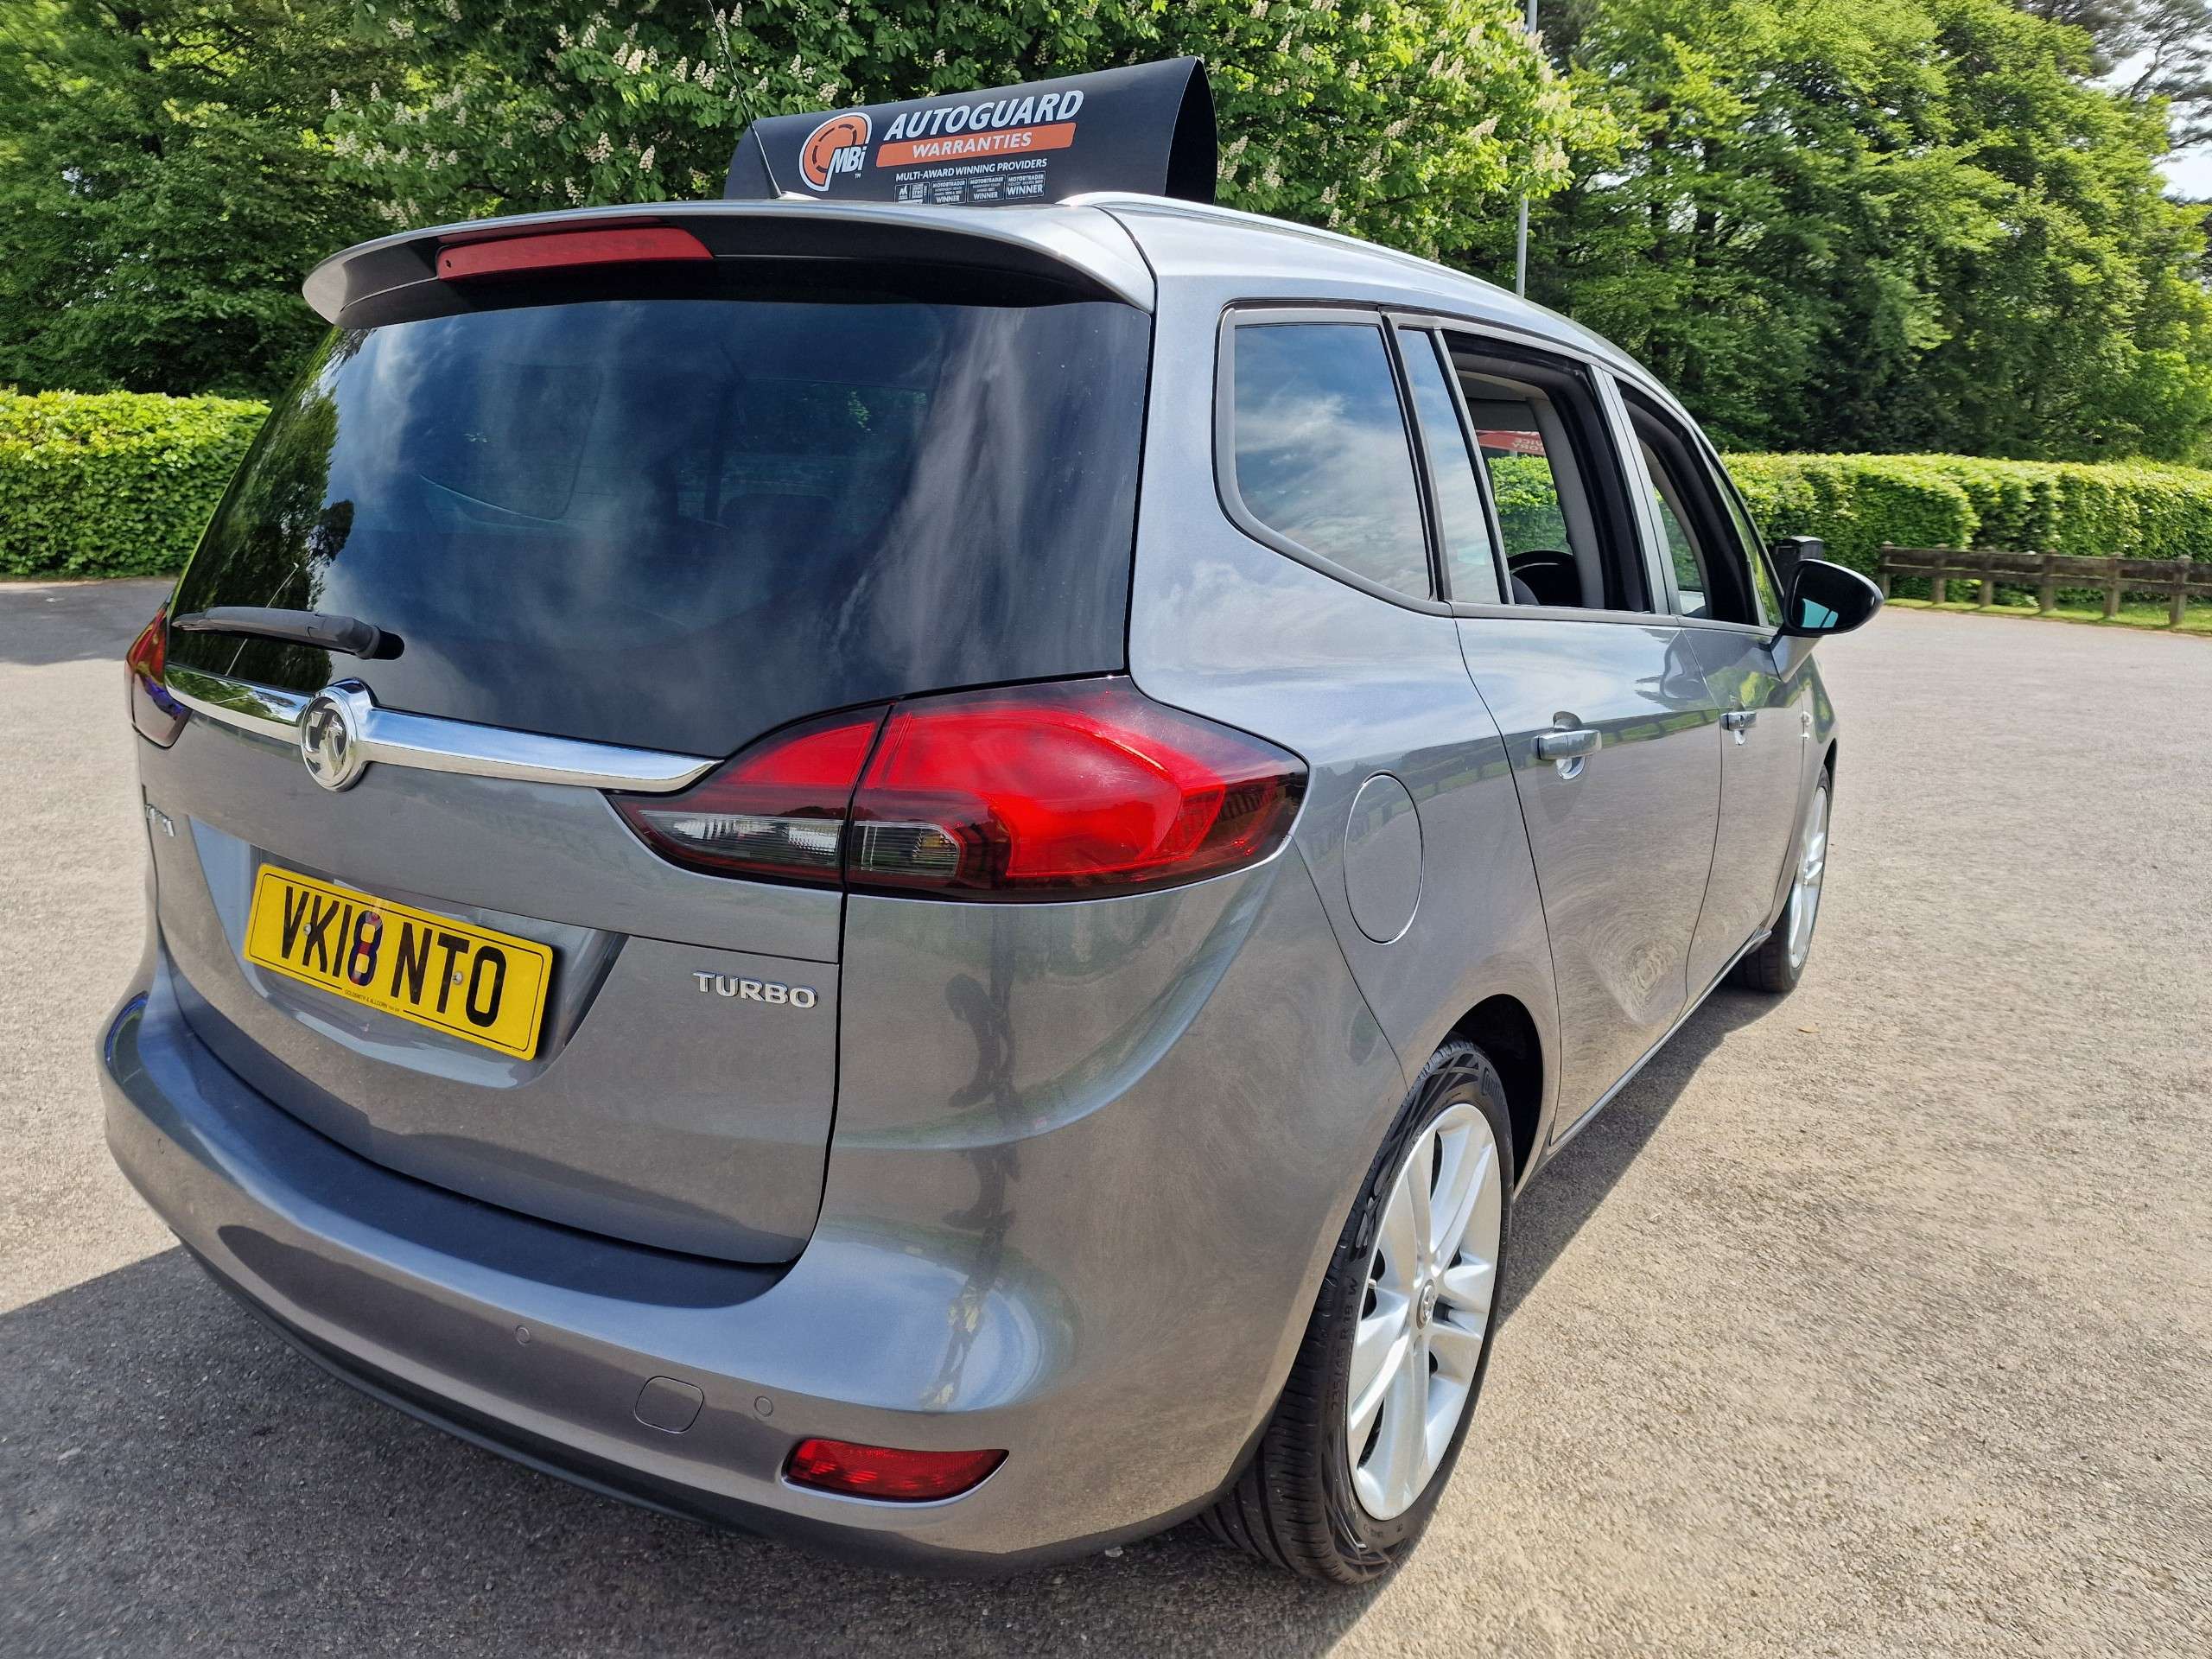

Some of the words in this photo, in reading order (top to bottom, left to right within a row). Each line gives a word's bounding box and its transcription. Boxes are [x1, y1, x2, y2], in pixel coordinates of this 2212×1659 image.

[884, 90, 1084, 142] AUTOGUARD
[912, 132, 1032, 158] WARRANTIES
[895, 168, 954, 182] MULTI-AWARD
[955, 163, 995, 176] WINNING
[997, 158, 1048, 171] PROVIDERS
[936, 194, 961, 203] WINNER
[973, 192, 998, 200] WINNER
[1007, 184, 1043, 195] WINNER
[281, 886, 384, 987] VK18
[390, 922, 507, 1028] NTO
[693, 970, 818, 1009] TURBO
